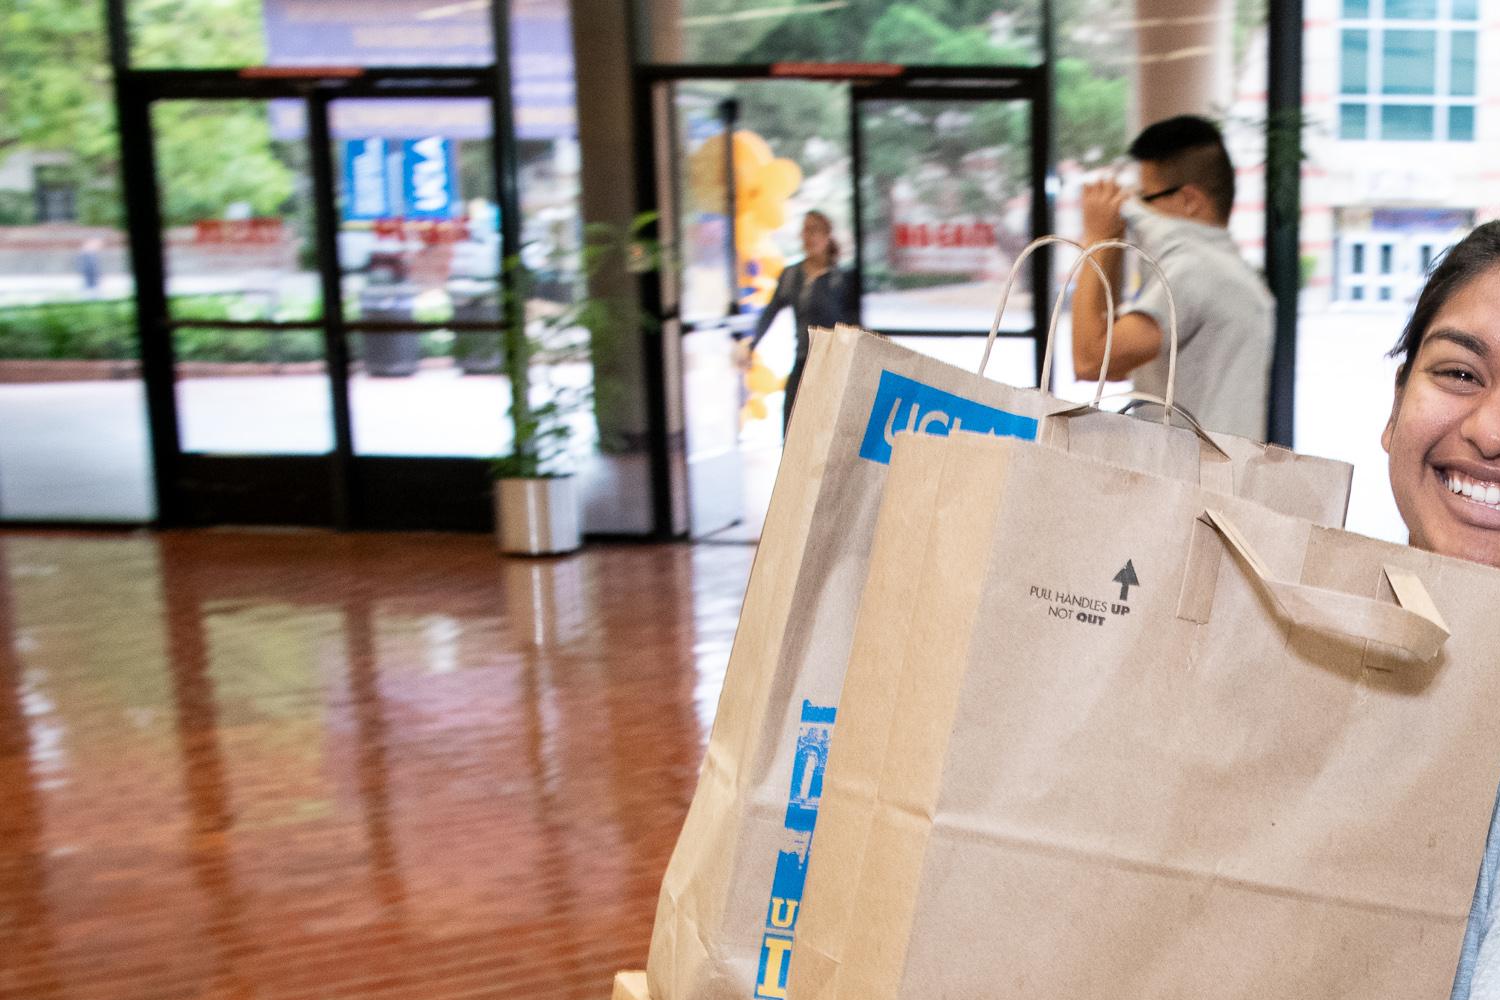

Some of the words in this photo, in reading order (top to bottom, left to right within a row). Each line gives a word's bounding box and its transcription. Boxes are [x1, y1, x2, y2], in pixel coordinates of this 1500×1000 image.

[1030, 585, 1053, 602] PULL
[1056, 591, 1108, 613] HANDLES
[1111, 603, 1131, 616] UP
[1048, 605, 1075, 620] NOT
[1076, 612, 1106, 626] OUT
